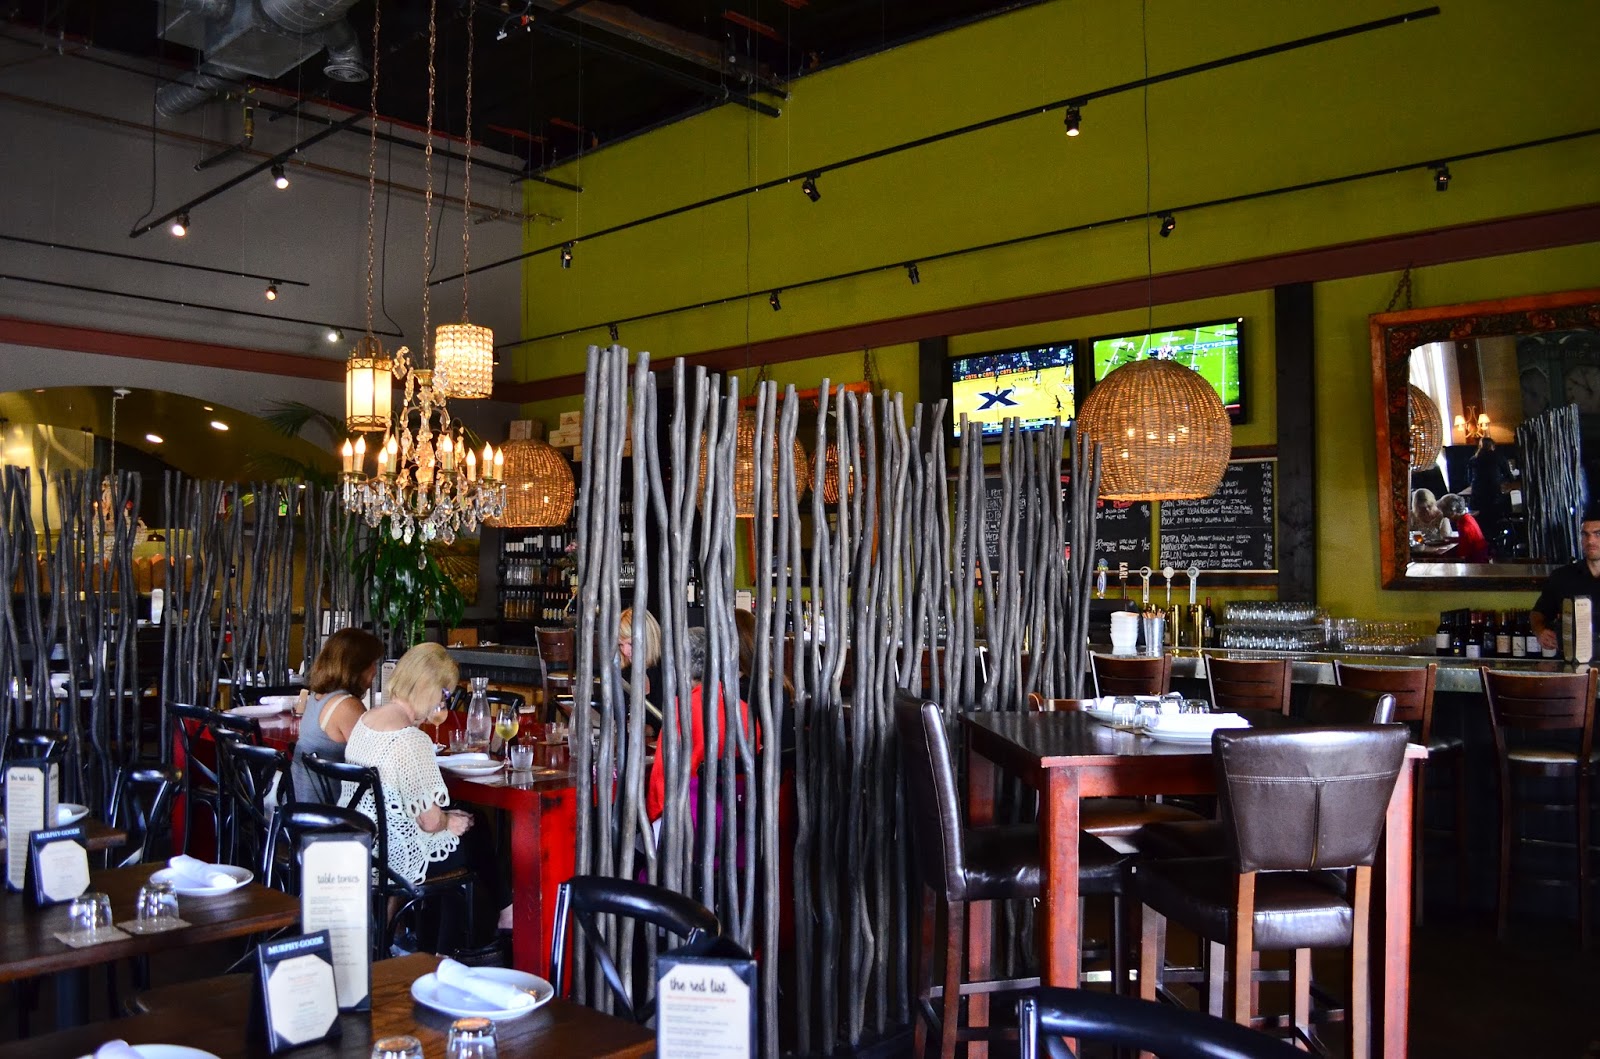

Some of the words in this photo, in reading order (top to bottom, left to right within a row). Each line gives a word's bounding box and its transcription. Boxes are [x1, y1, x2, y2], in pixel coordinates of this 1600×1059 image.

[1119, 562, 1129, 580] KARL
[36, 827, 81, 840] MURPHY-GOODE
[317, 872, 335, 884] table
[267, 935, 325, 956] MURPHY-GOODE
[669, 977, 686, 992] the
[690, 978, 707, 992] red
[710, 978, 728, 994] list
